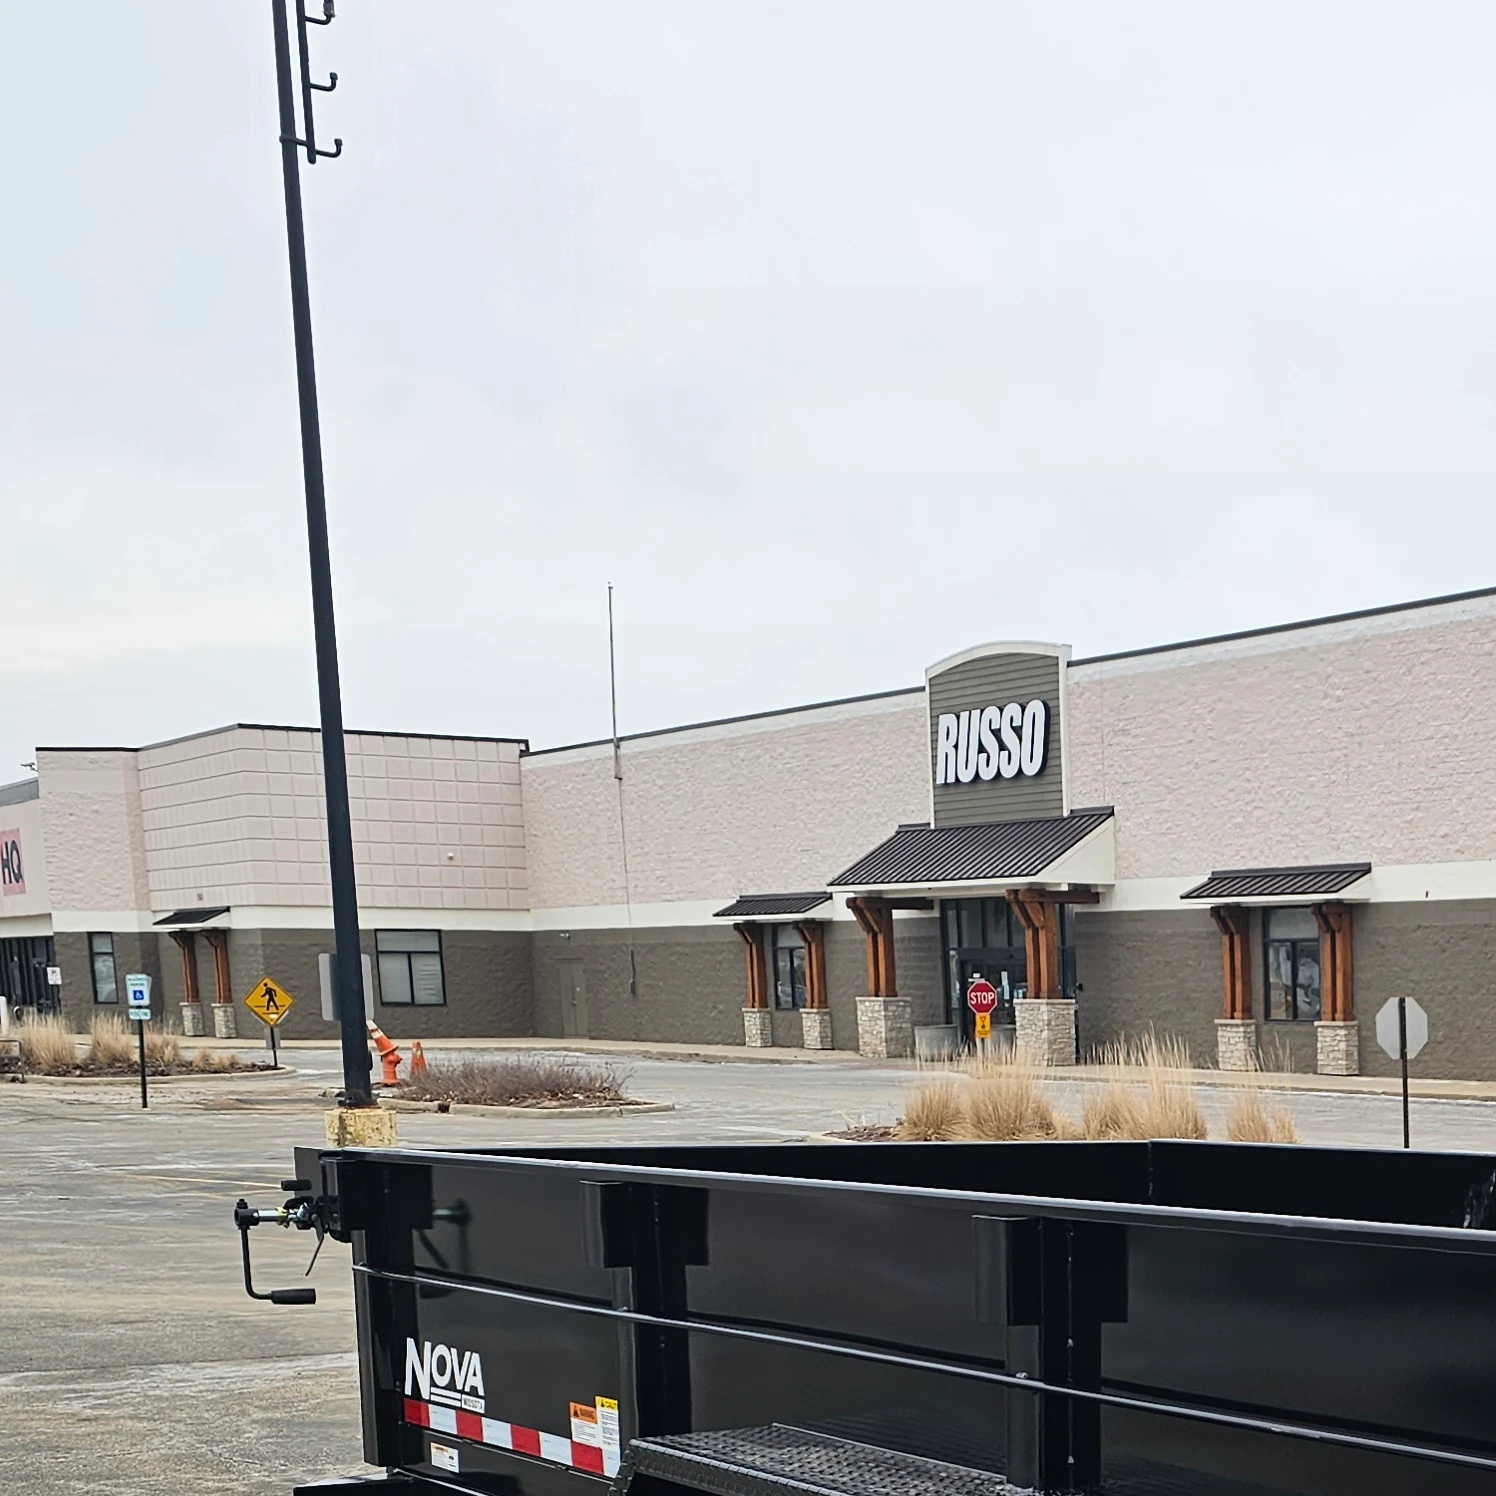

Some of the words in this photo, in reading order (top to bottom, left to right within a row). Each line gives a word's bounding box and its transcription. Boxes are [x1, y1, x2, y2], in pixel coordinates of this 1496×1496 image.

[936, 699, 1047, 784] RUSSO
[0, 840, 24, 885] HQ
[970, 992, 995, 1005] STOP
[405, 1337, 485, 1400] NOVA
